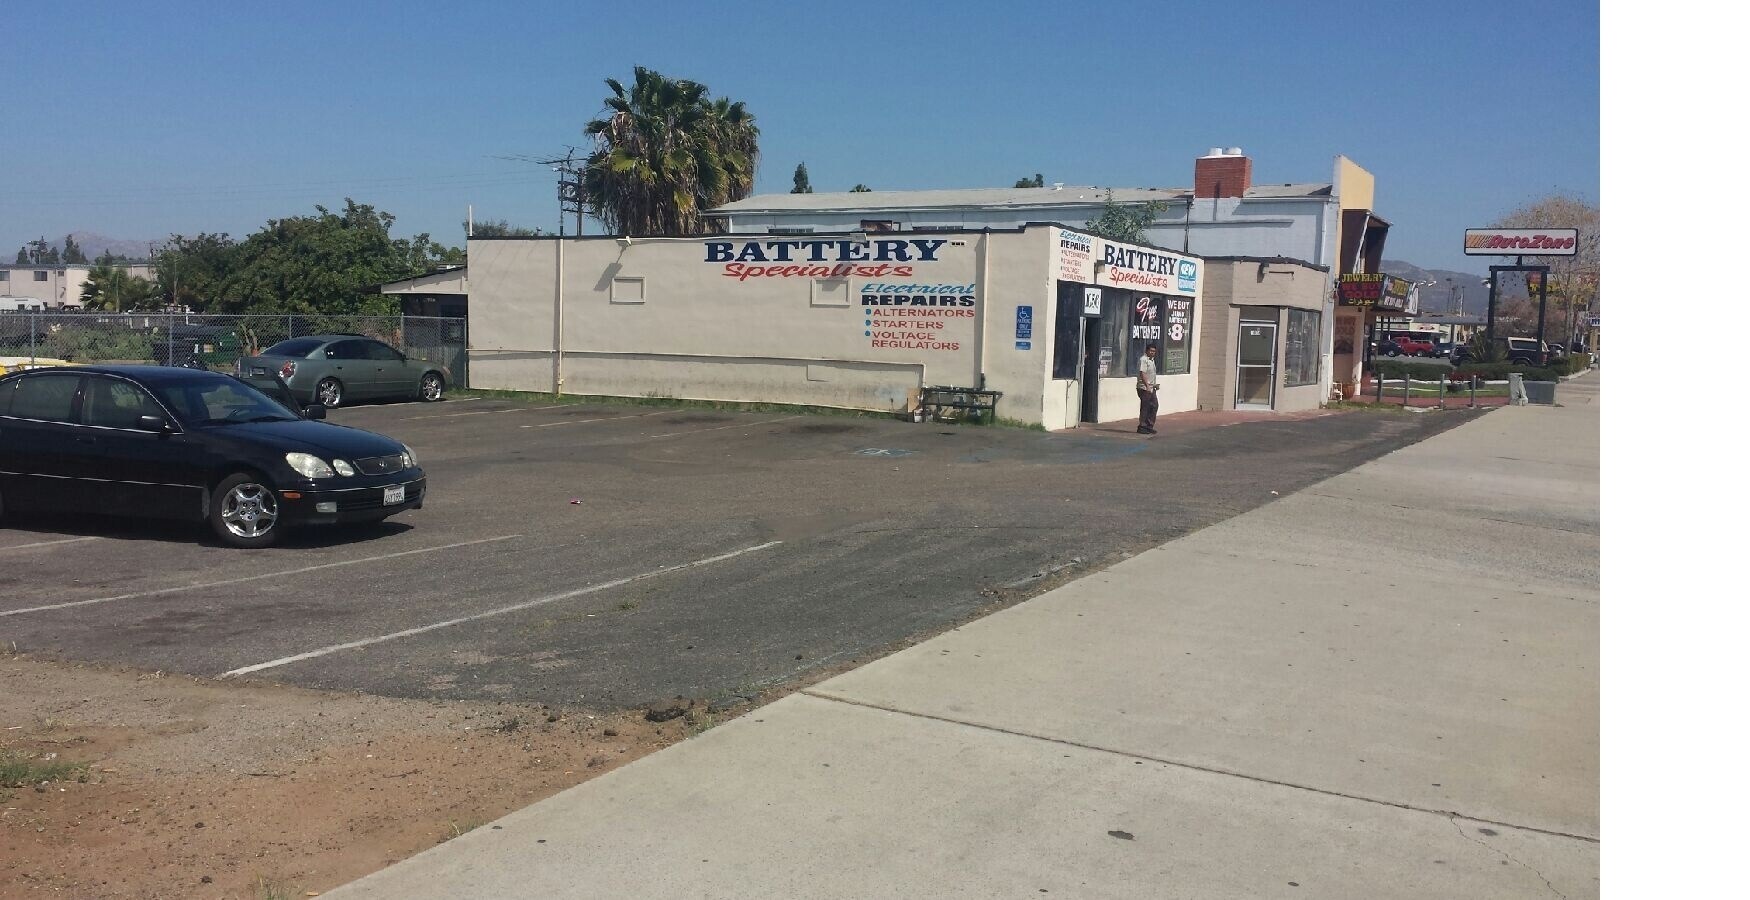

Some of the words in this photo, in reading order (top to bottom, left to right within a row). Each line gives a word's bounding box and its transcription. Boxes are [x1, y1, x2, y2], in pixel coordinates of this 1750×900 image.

[1060, 239, 1091, 254] REPAIRS
[1488, 234, 1575, 250] AutoZone
[704, 239, 948, 262] BATTERY
[1105, 243, 1178, 276] BATTERY
[722, 263, 913, 281] Specialists
[1109, 266, 1169, 289] Specialists
[1342, 273, 1385, 282] JEWELRY
[861, 283, 976, 294] Electrical
[861, 295, 976, 306] REPAIRS
[1167, 300, 1178, 309] WE
[873, 308, 975, 318] ALTERNATORS
[872, 319, 944, 329] STARTERS
[872, 330, 936, 340] VOLTAGE
[872, 339, 960, 350] REGULATORS
